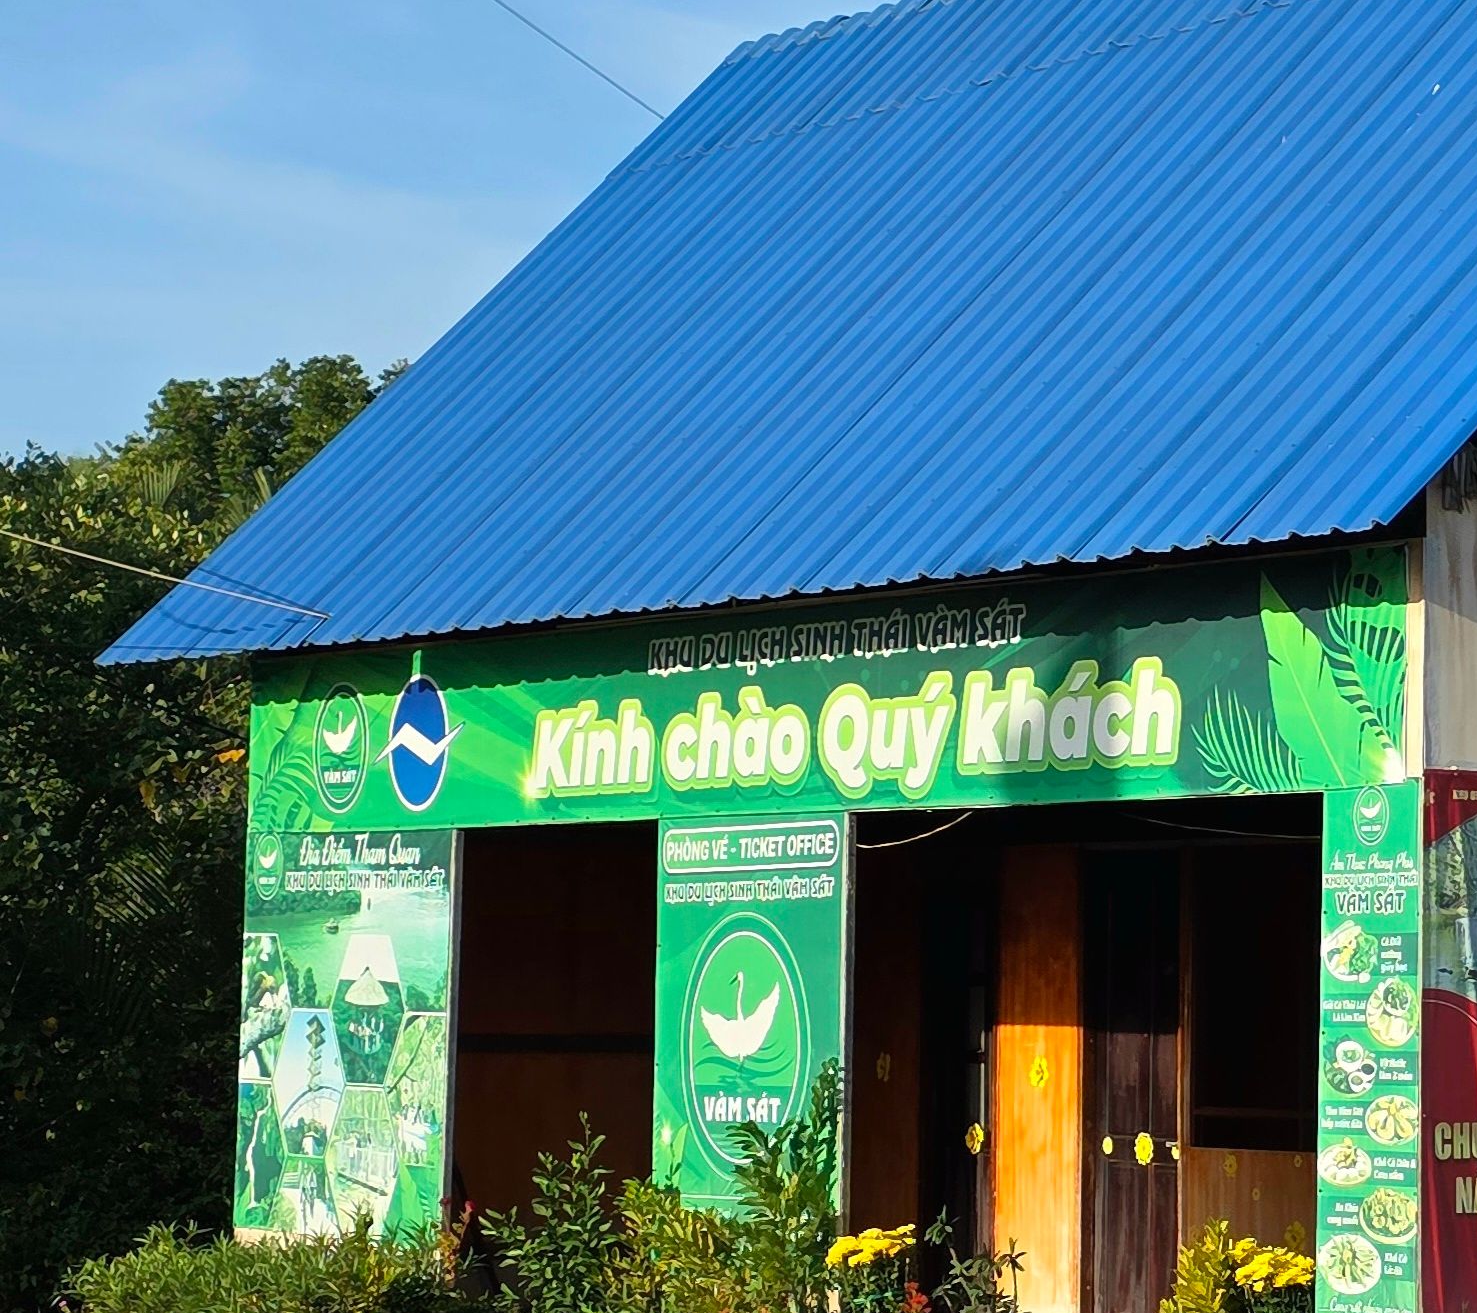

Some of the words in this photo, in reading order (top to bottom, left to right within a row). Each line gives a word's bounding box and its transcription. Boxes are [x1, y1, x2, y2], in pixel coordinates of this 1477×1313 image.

[648, 637, 695, 676] KHU
[700, 632, 732, 670] DU
[735, 625, 785, 675] LỊCH
[790, 620, 846, 662] SINH
[852, 610, 908, 657] THÁI
[916, 604, 971, 653] VÀM
[975, 597, 1026, 647] SÁT
[528, 703, 653, 793] Kính
[664, 691, 808, 786] chào
[820, 672, 952, 794] Quý
[960, 661, 1180, 774] khách
[355, 832, 387, 866] Tham
[388, 833, 420, 865] Quan
[666, 836, 710, 863] PHÒNG
[711, 834, 728, 860] VÉ
[739, 835, 786, 859] TICKET
[786, 832, 834, 856] OFFICE
[285, 871, 306, 893] KHU
[348, 869, 371, 890] SINH
[372, 866, 398, 890] THÁI
[664, 884, 686, 904] KHU
[686, 883, 702, 902] DU
[703, 882, 727, 906] LỊCH
[728, 881, 755, 902] SINH
[755, 876, 783, 902] THÁI
[784, 875, 810, 900] VÀM
[811, 874, 835, 898] SÁT
[1335, 887, 1371, 916] VÀM
[1374, 886, 1406, 915] SÁT
[703, 1090, 742, 1123] VÀM
[745, 1091, 782, 1124] SÁT
